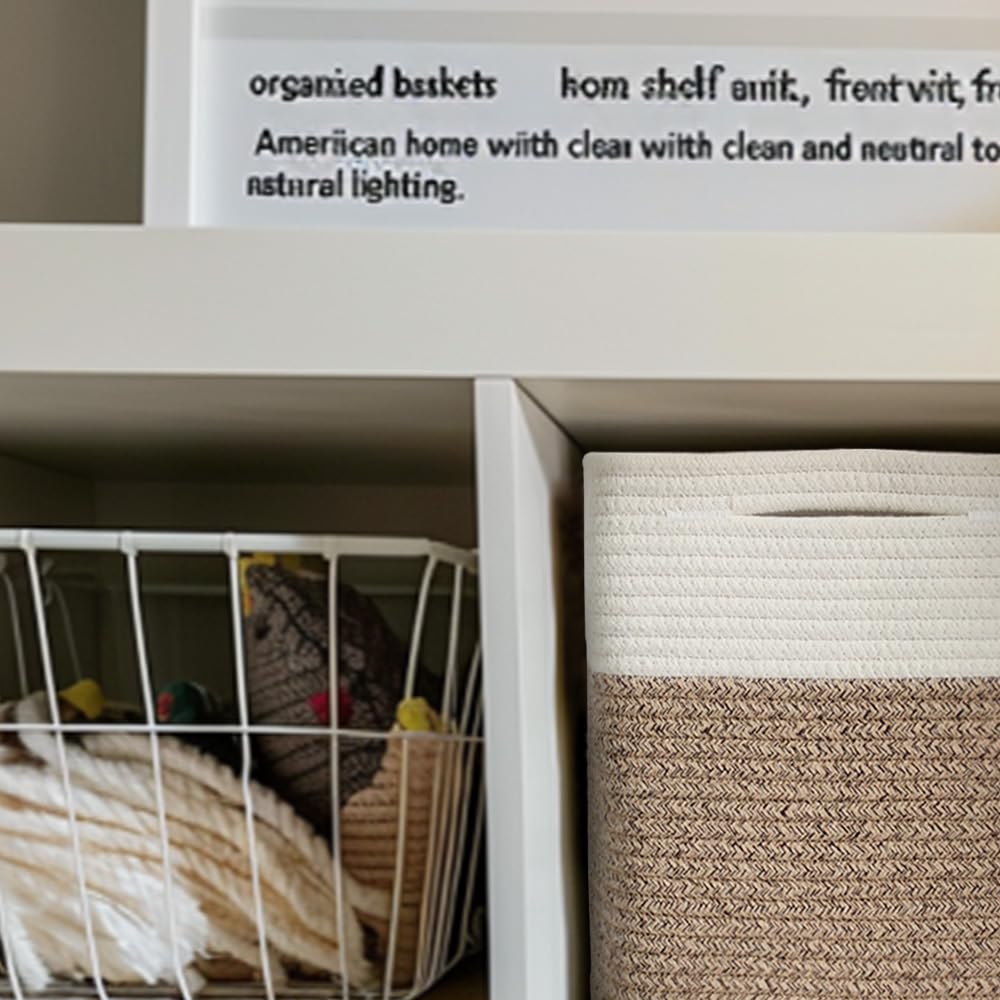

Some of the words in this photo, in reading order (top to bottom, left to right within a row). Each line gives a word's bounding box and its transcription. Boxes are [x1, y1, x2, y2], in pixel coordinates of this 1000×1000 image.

[405, 128, 480, 157] home
[722, 130, 795, 161] clean
[801, 132, 852, 162] and
[352, 168, 466, 205] lighting.
